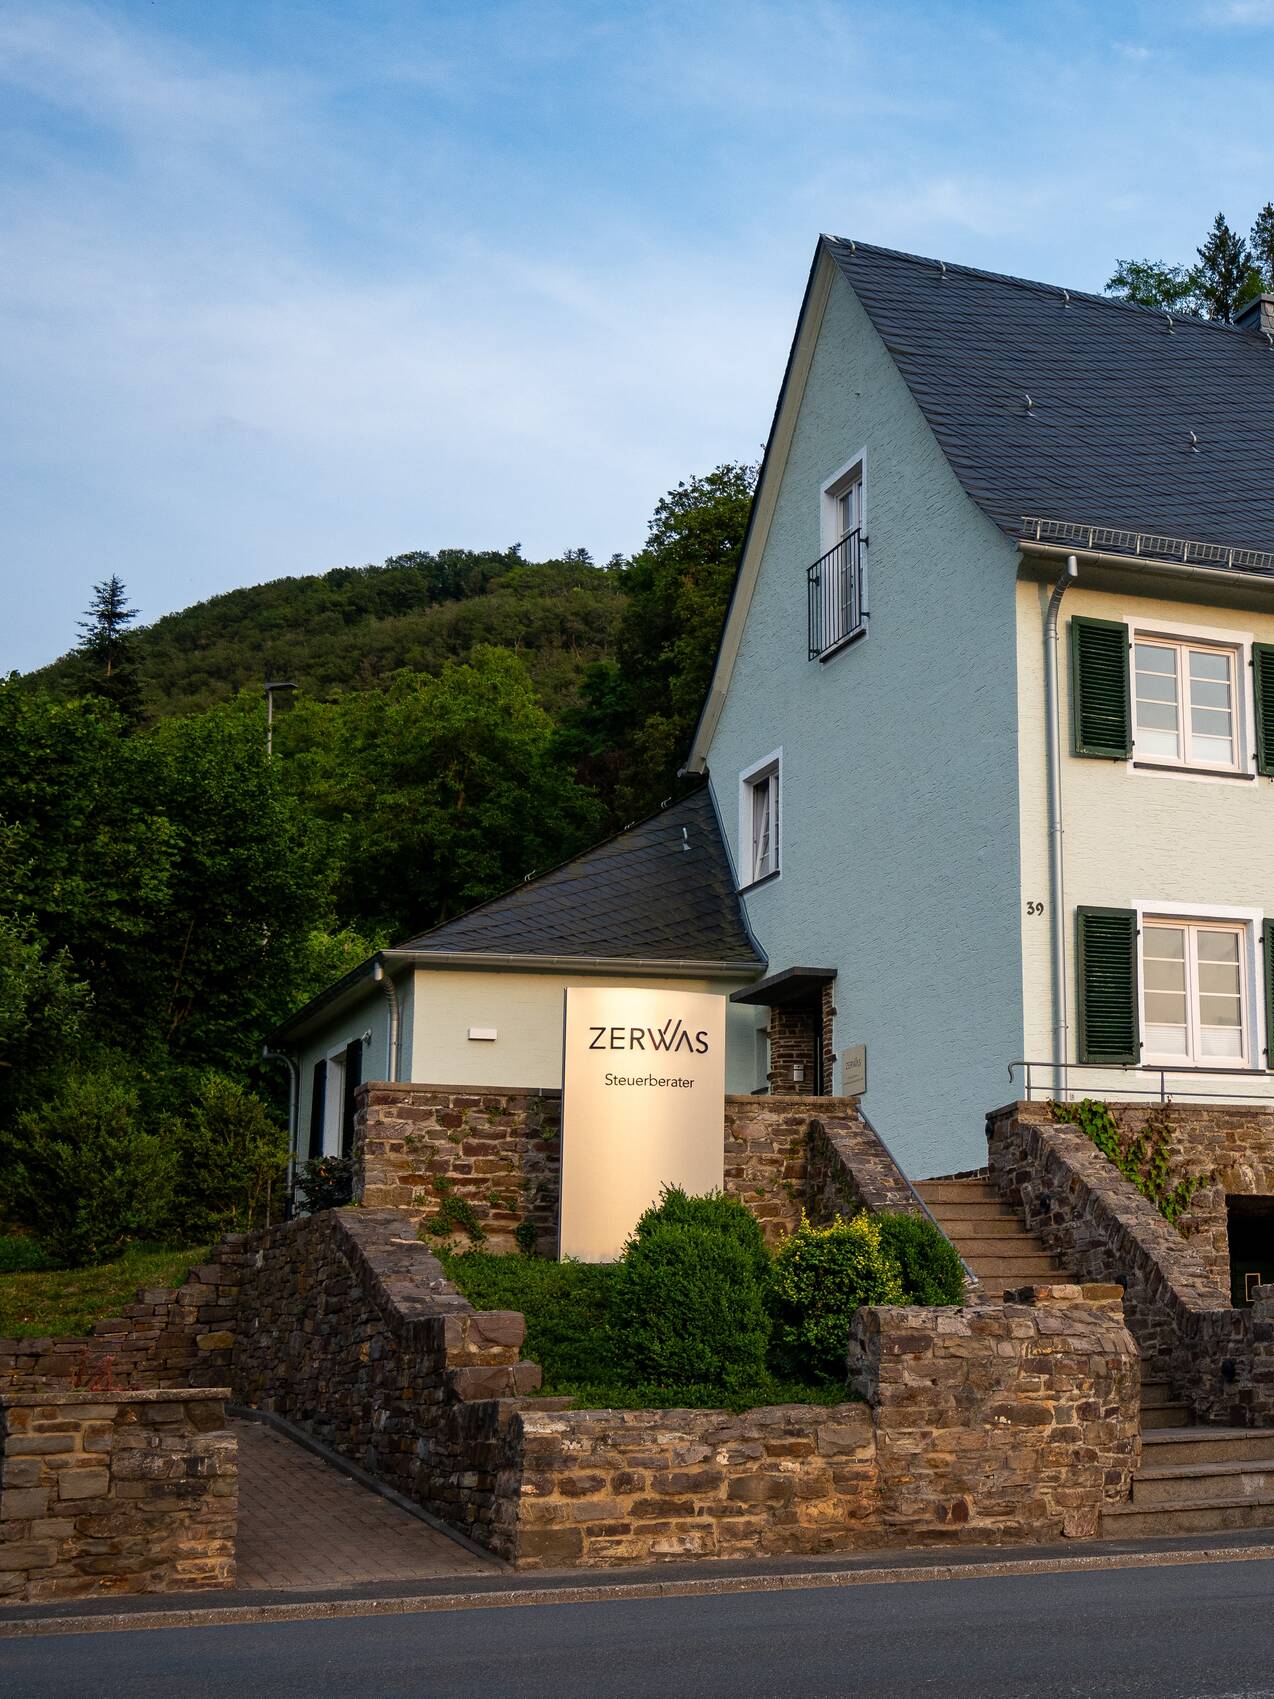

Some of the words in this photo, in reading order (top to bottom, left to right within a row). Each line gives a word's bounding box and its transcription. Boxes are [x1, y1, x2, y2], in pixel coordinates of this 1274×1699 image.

[1026, 901, 1044, 916] 39
[588, 1018, 709, 1054] ZERWAS
[604, 1073, 695, 1088] Steuerberater
